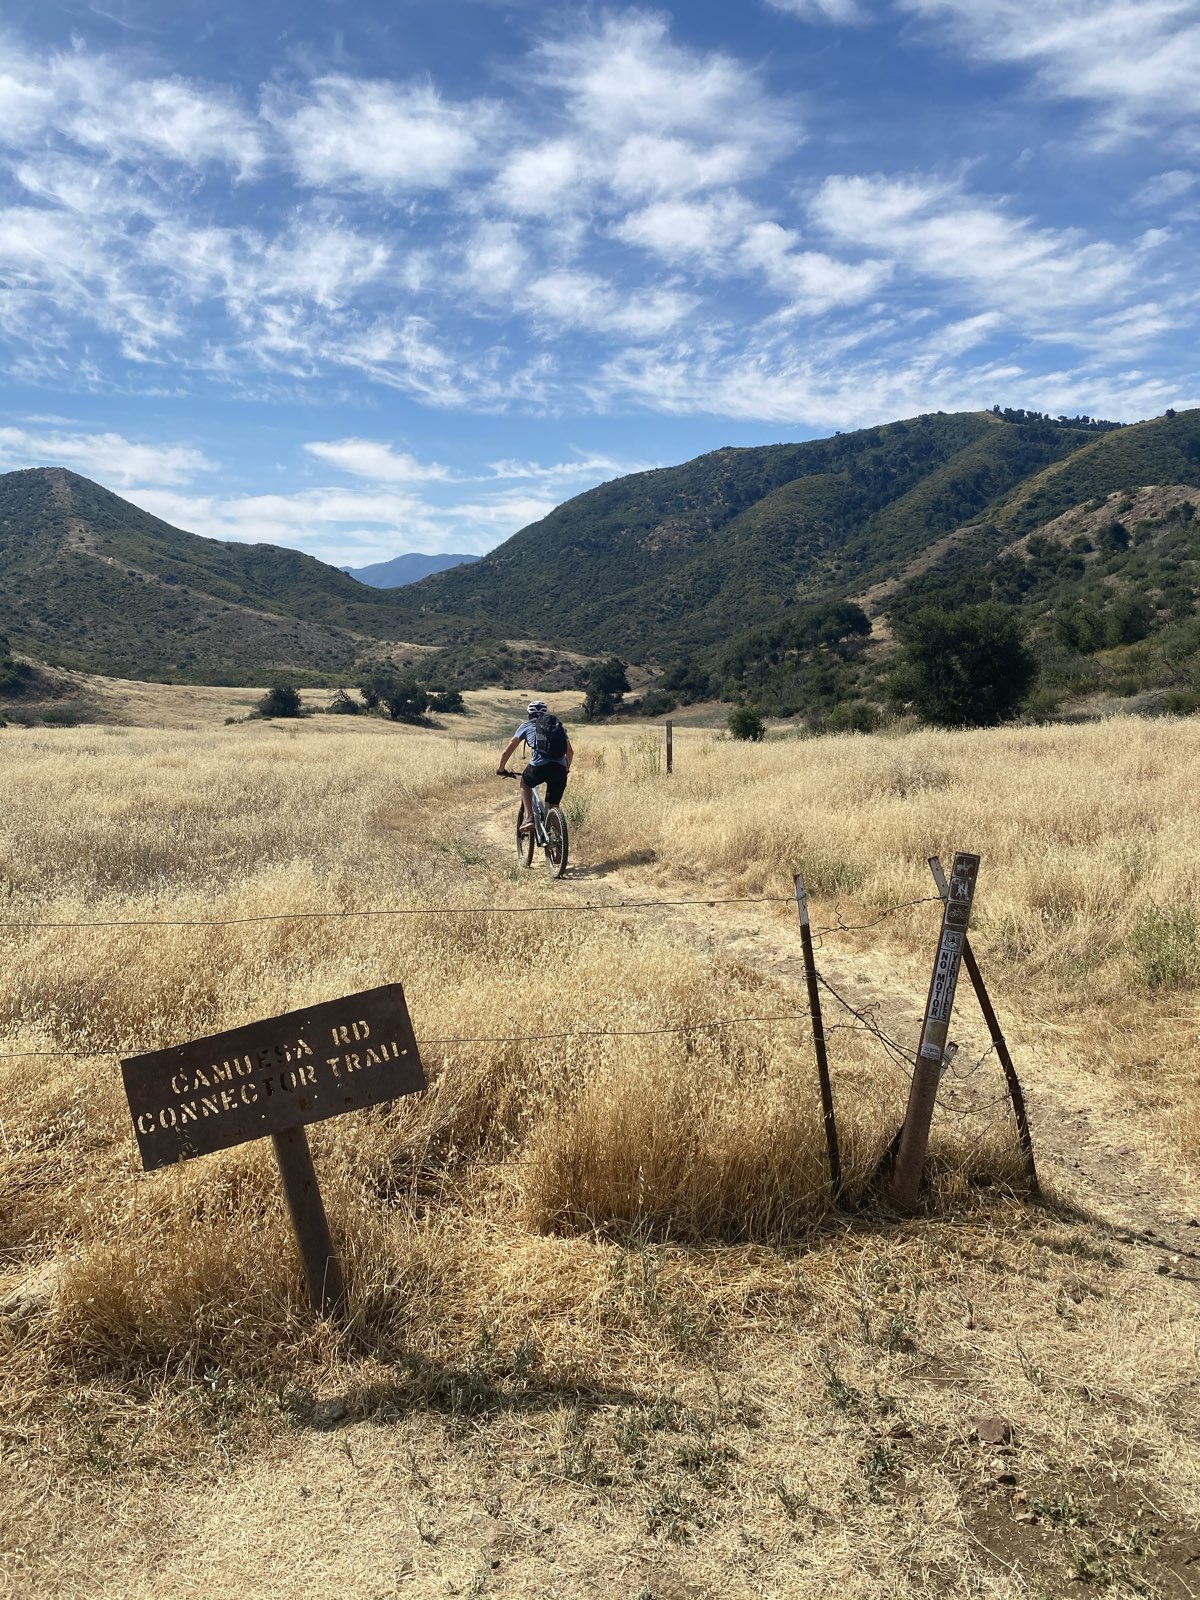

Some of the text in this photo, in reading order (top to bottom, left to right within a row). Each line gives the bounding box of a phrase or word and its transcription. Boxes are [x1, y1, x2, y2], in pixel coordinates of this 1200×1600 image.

[931, 951, 949, 1017] NO MOTOR
[941, 953, 959, 1020] VEHICLES
[136, 1041, 408, 1135] CONNECTOR TRAIL
[171, 1020, 371, 1095] CAMUESA RD
